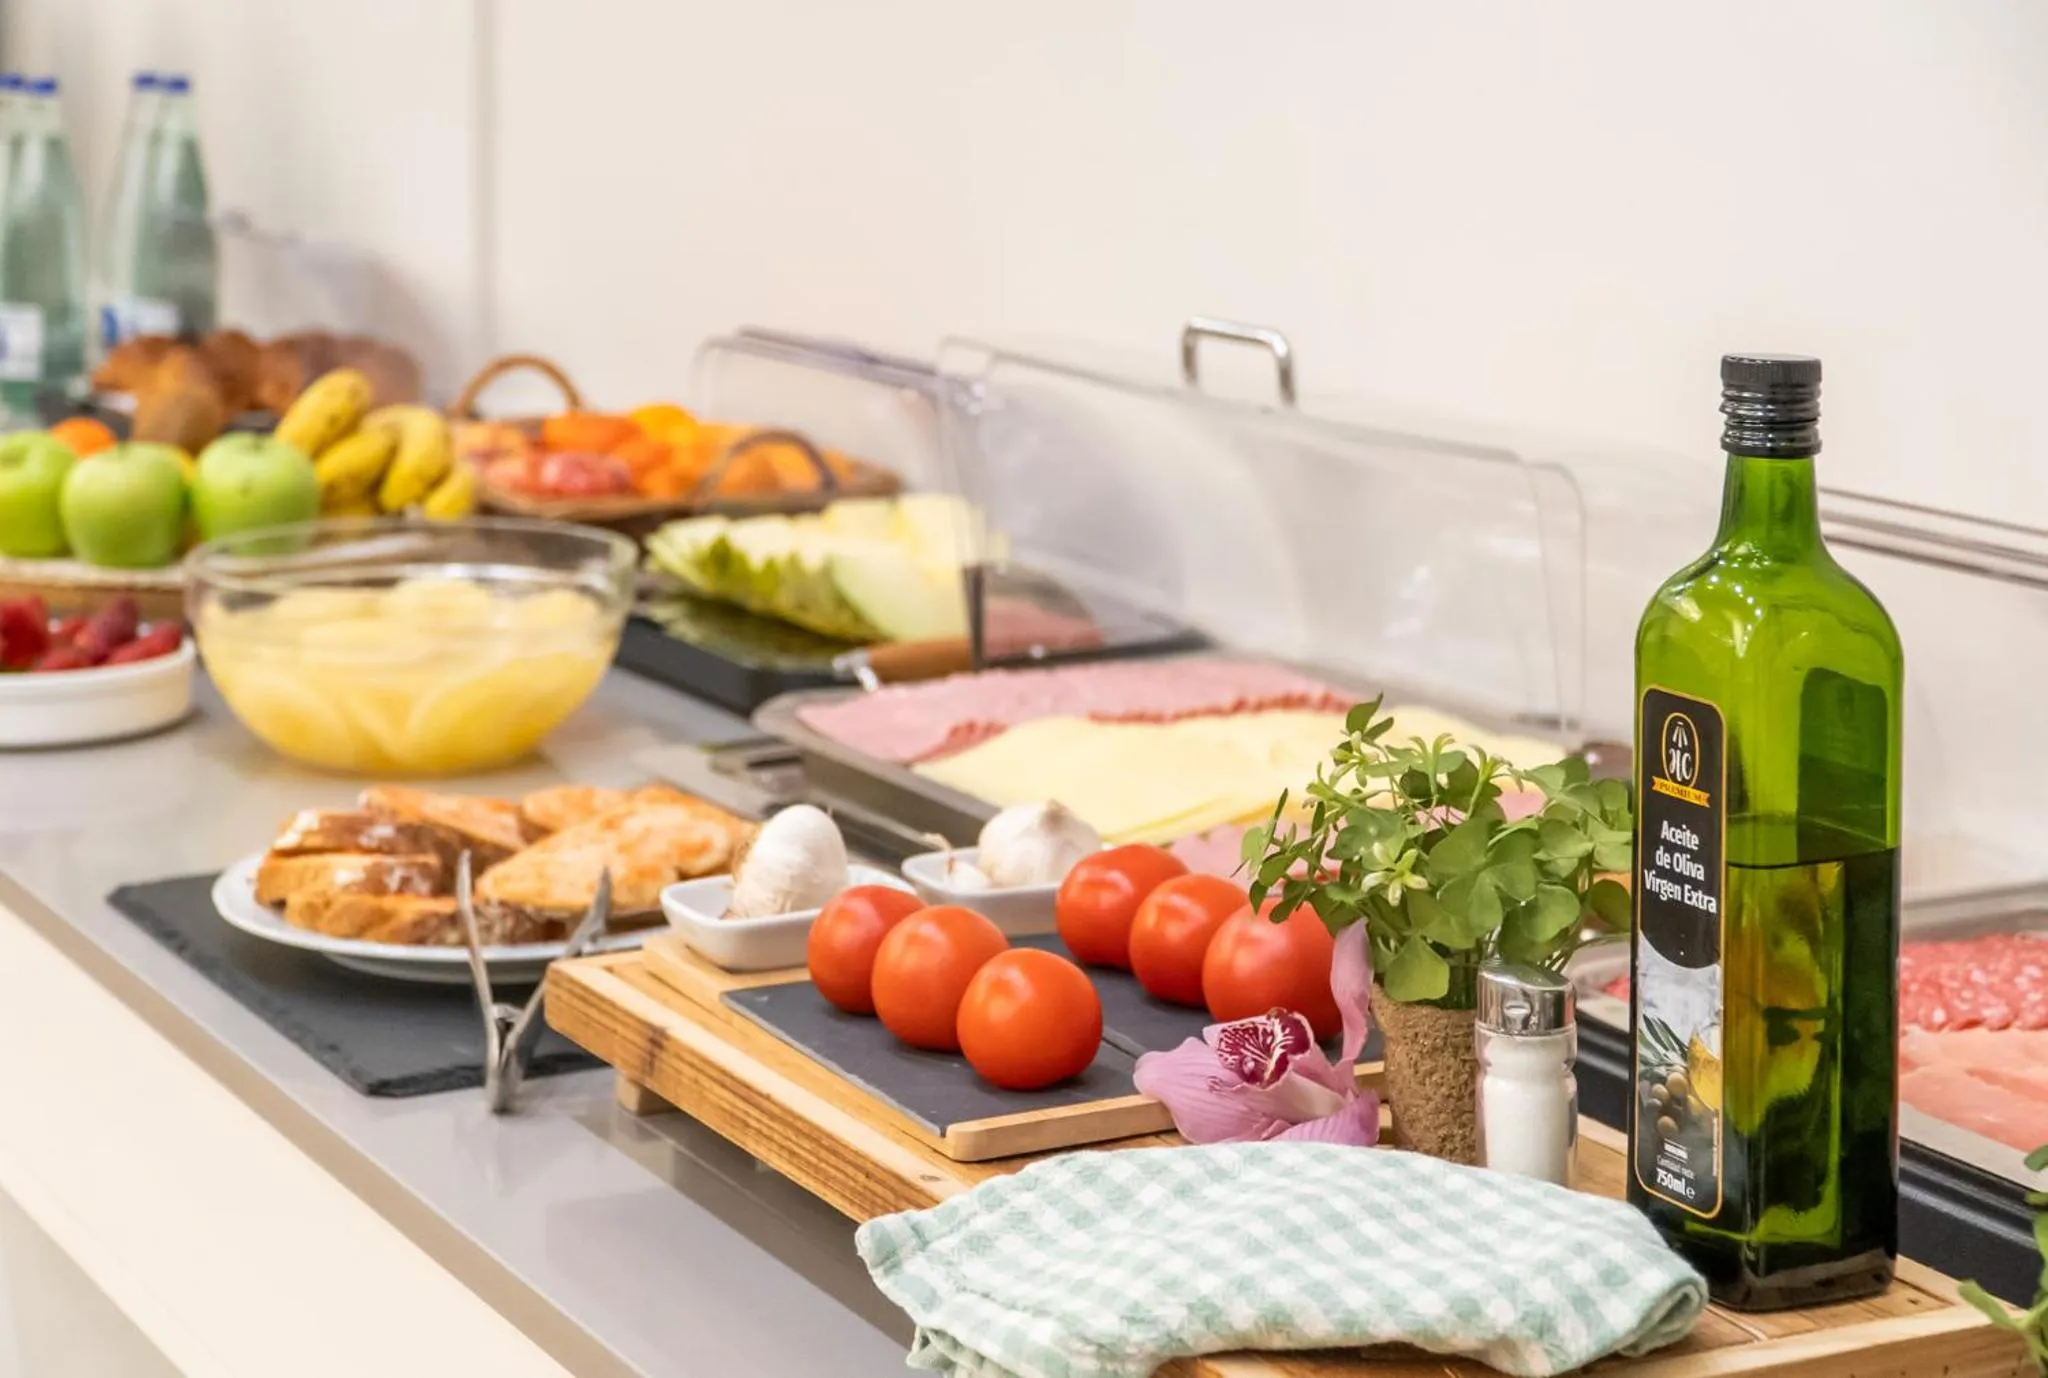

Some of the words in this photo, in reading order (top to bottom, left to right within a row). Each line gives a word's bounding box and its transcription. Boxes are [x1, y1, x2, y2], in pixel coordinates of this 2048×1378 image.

[1660, 820, 1700, 850] Aceite
[1655, 845, 1671, 869] de
[1673, 852, 1705, 881] Oliva
[1644, 869, 1682, 901] Virgen
[1684, 883, 1717, 914] Extra
[1656, 1167, 1686, 1195] 750ml
